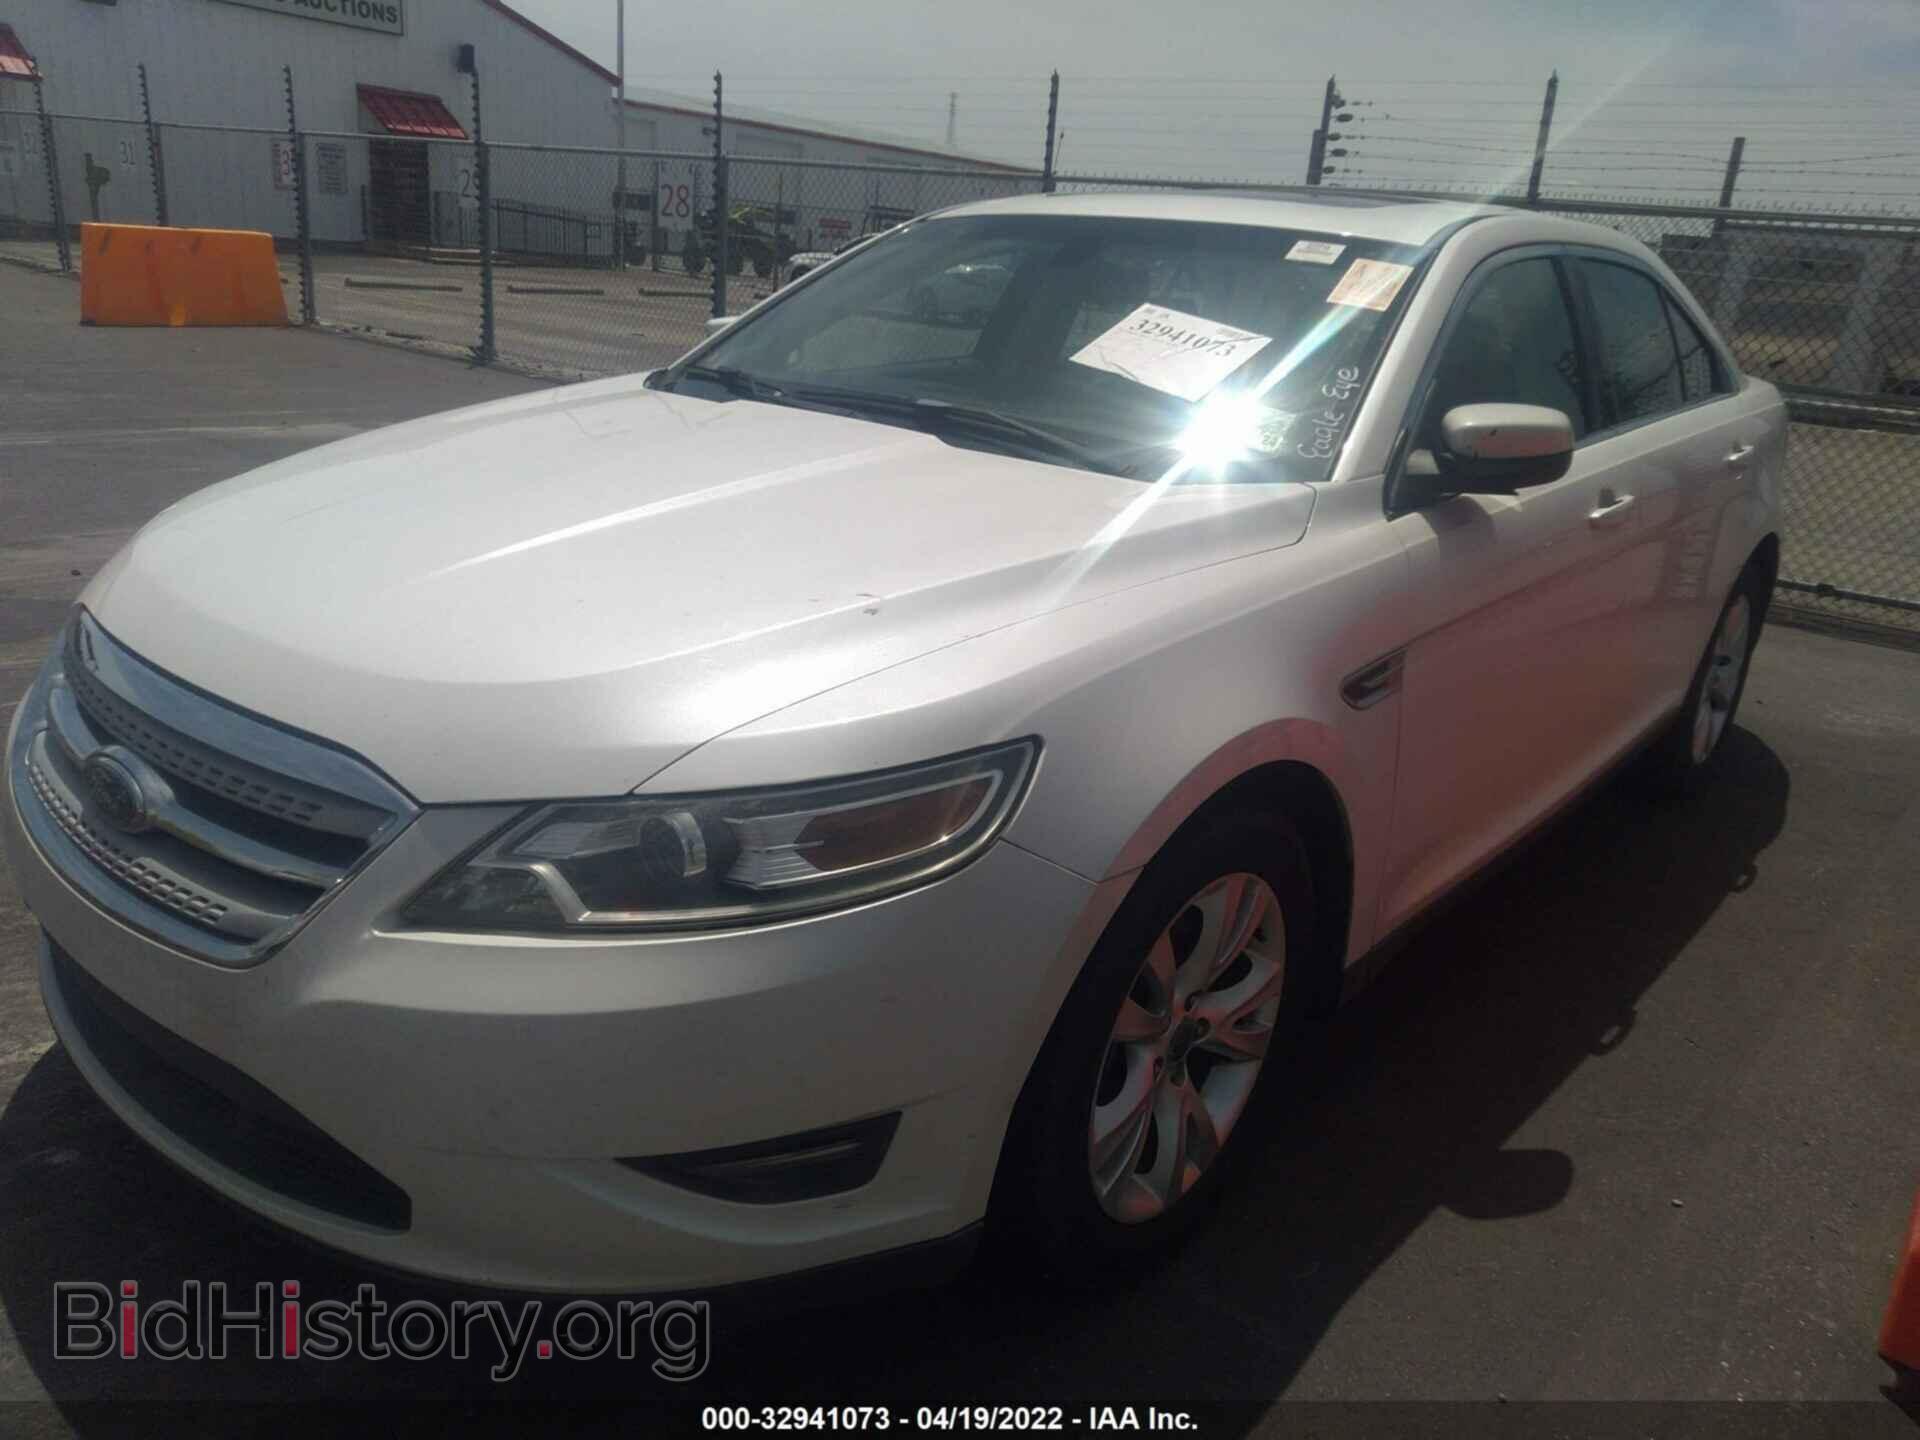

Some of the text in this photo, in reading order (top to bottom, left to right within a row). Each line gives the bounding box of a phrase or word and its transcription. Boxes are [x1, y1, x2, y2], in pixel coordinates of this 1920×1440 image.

[661, 183, 689, 218] 28
[1129, 319, 1237, 357] 32941073
[1297, 366, 1361, 458] Eagle Eye
